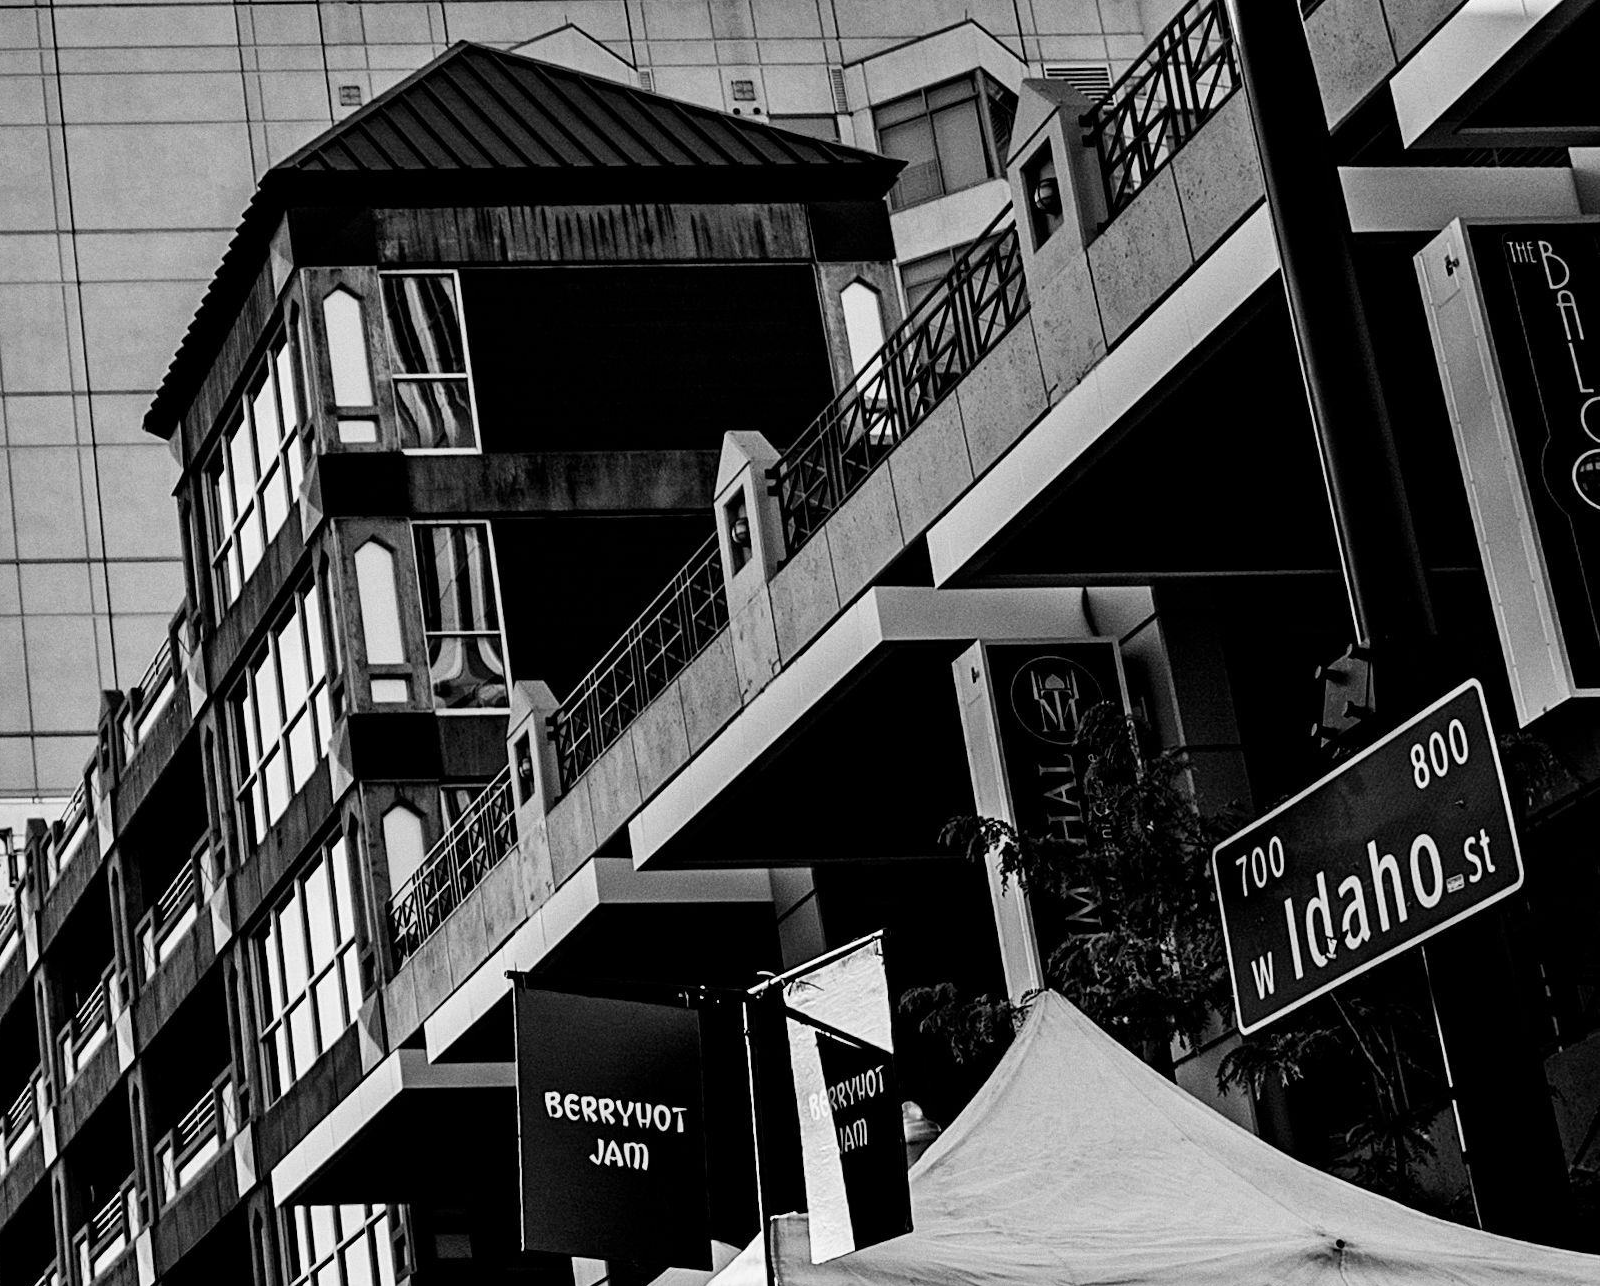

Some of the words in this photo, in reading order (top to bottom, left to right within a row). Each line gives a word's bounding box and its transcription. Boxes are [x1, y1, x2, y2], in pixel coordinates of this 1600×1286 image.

[1506, 240, 1538, 265] THE
[1409, 717, 1470, 791] 800
[1234, 835, 1285, 897] 700
[1284, 832, 1444, 980] Idaho
[543, 1090, 688, 1134] BERRYHOT
[807, 1065, 886, 1121] BERRYHOT
[588, 1138, 650, 1172] JAM
[837, 1117, 869, 1155] JAM
